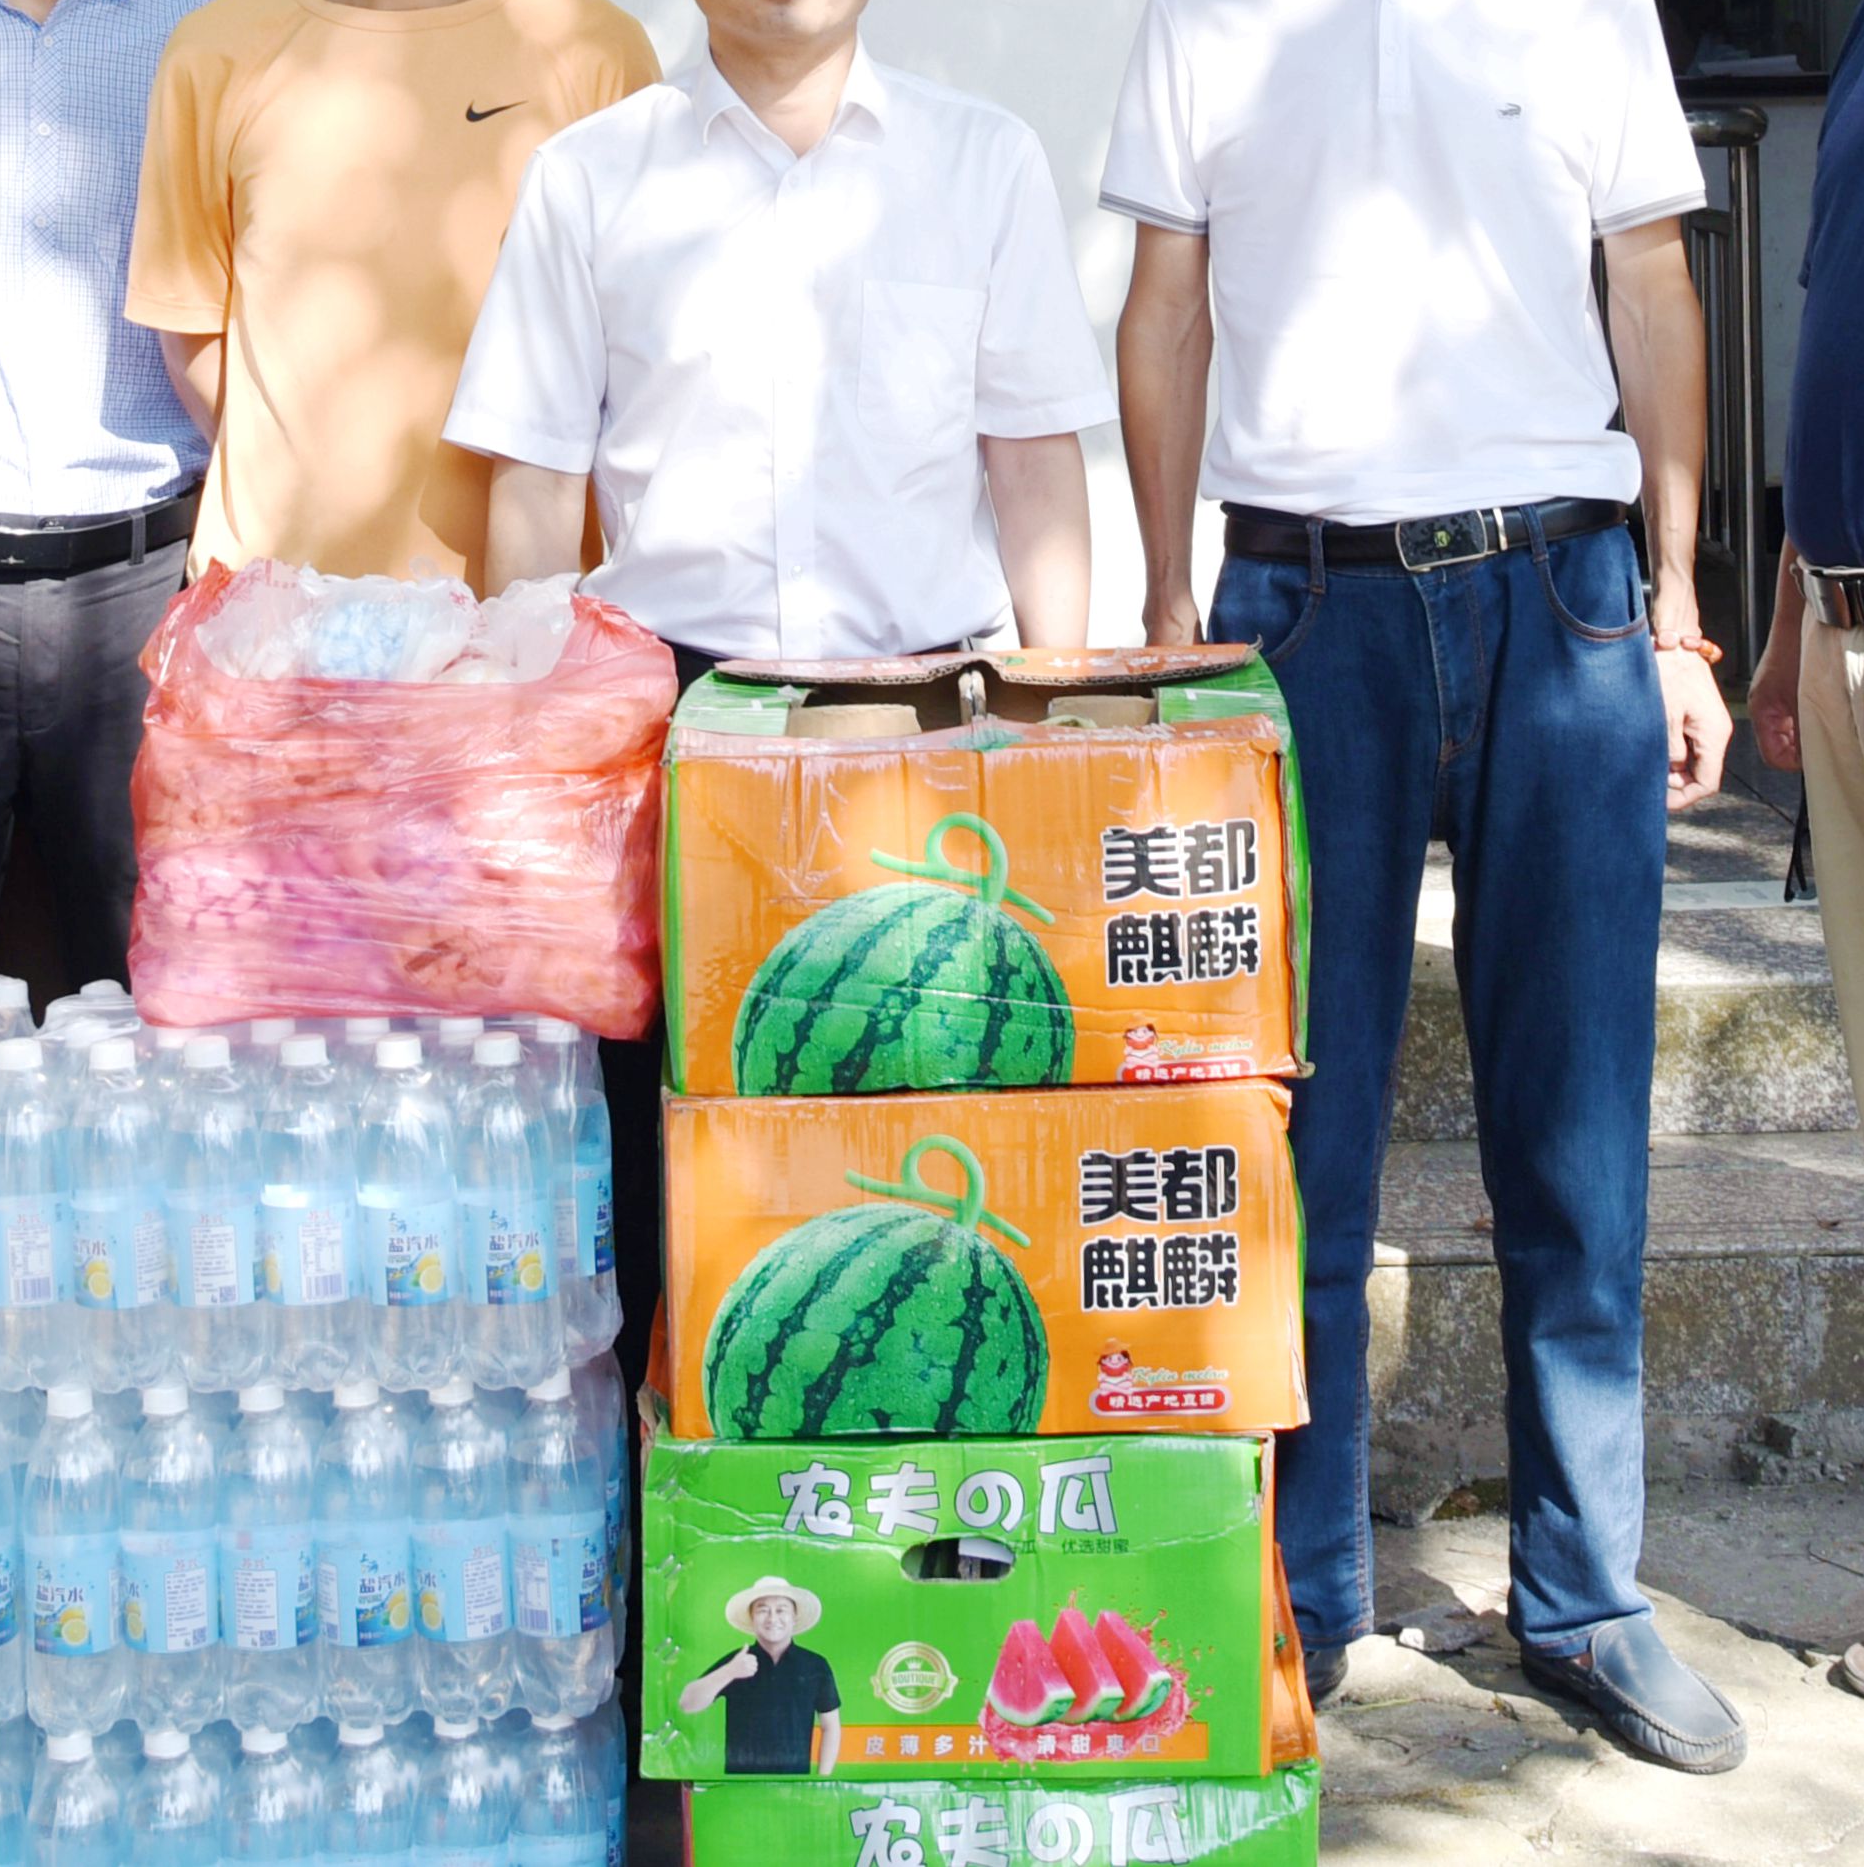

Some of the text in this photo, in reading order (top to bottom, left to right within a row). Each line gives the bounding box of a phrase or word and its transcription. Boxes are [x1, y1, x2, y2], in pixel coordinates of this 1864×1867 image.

[1102, 819, 1258, 901] 美都
[1105, 905, 1260, 987] 麒麟
[1080, 1146, 1238, 1224] 美都
[1082, 1232, 1239, 1311] 麒麟
[780, 1455, 1119, 1536] 农夫の瓜
[1061, 1538, 1130, 1555] 优选甜蜜
[849, 1785, 1190, 1867] 农夫の瓜
